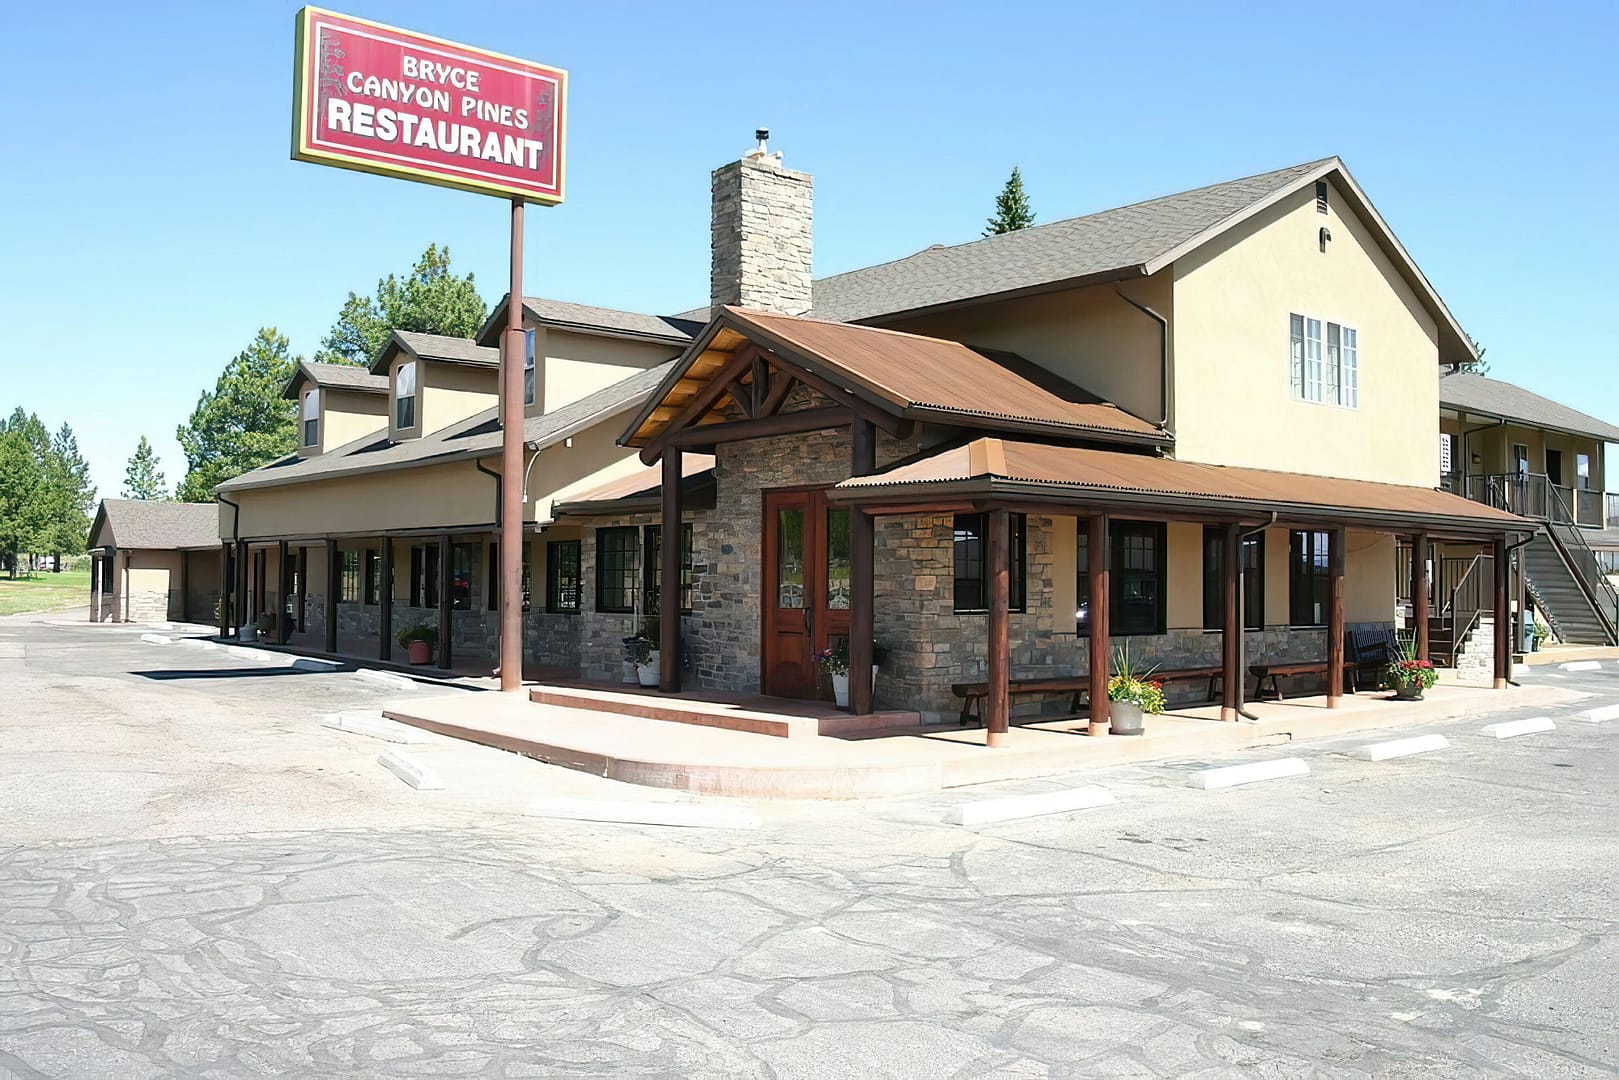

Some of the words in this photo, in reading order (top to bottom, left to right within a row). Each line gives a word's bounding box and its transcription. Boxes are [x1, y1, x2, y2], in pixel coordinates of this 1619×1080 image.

[346, 71, 449, 113] CANYON
[461, 96, 528, 129] PINES
[403, 55, 480, 92] BRYCE
[328, 98, 543, 170] RESTAURANT
